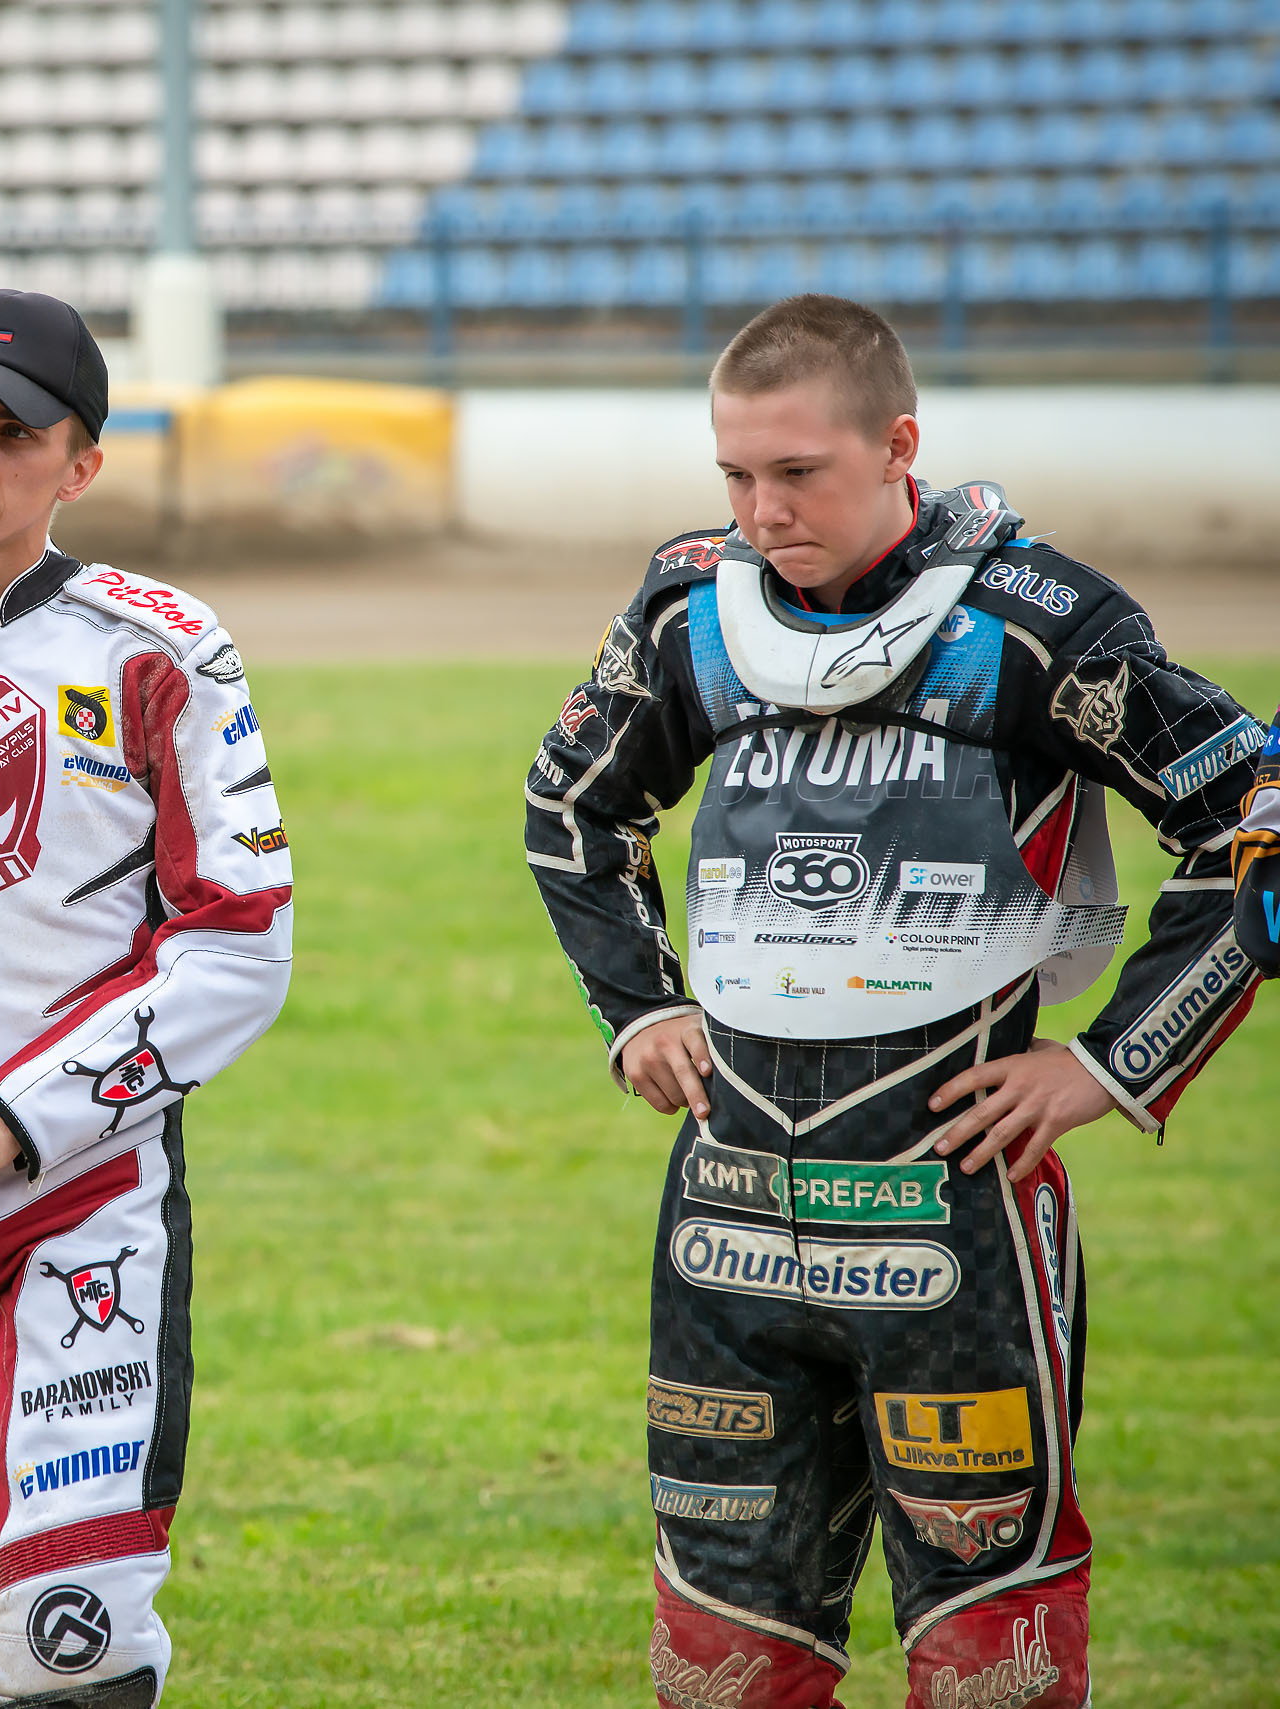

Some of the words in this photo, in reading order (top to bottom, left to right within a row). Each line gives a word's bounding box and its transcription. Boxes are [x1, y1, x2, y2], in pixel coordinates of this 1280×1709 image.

[11, 737, 35, 758] CLUB
[781, 838, 854, 851] MOTOSPORT
[773, 852, 861, 897] 360
[719, 933, 736, 942] TYRES
[900, 933, 951, 945] COLOUR
[951, 935, 981, 946] PRINT
[811, 987, 826, 995] VALD
[866, 979, 933, 992] PALMATIN
[118, 1060, 146, 1094] MTC
[697, 1157, 759, 1195] KMT
[682, 1226, 943, 1300] Õhumeister
[79, 1281, 110, 1304] MTC
[45, 1393, 135, 1424] FAMILY
[885, 1399, 978, 1444] LT
[704, 1495, 775, 1521] AUTO
[910, 1513, 1024, 1550] RENO
